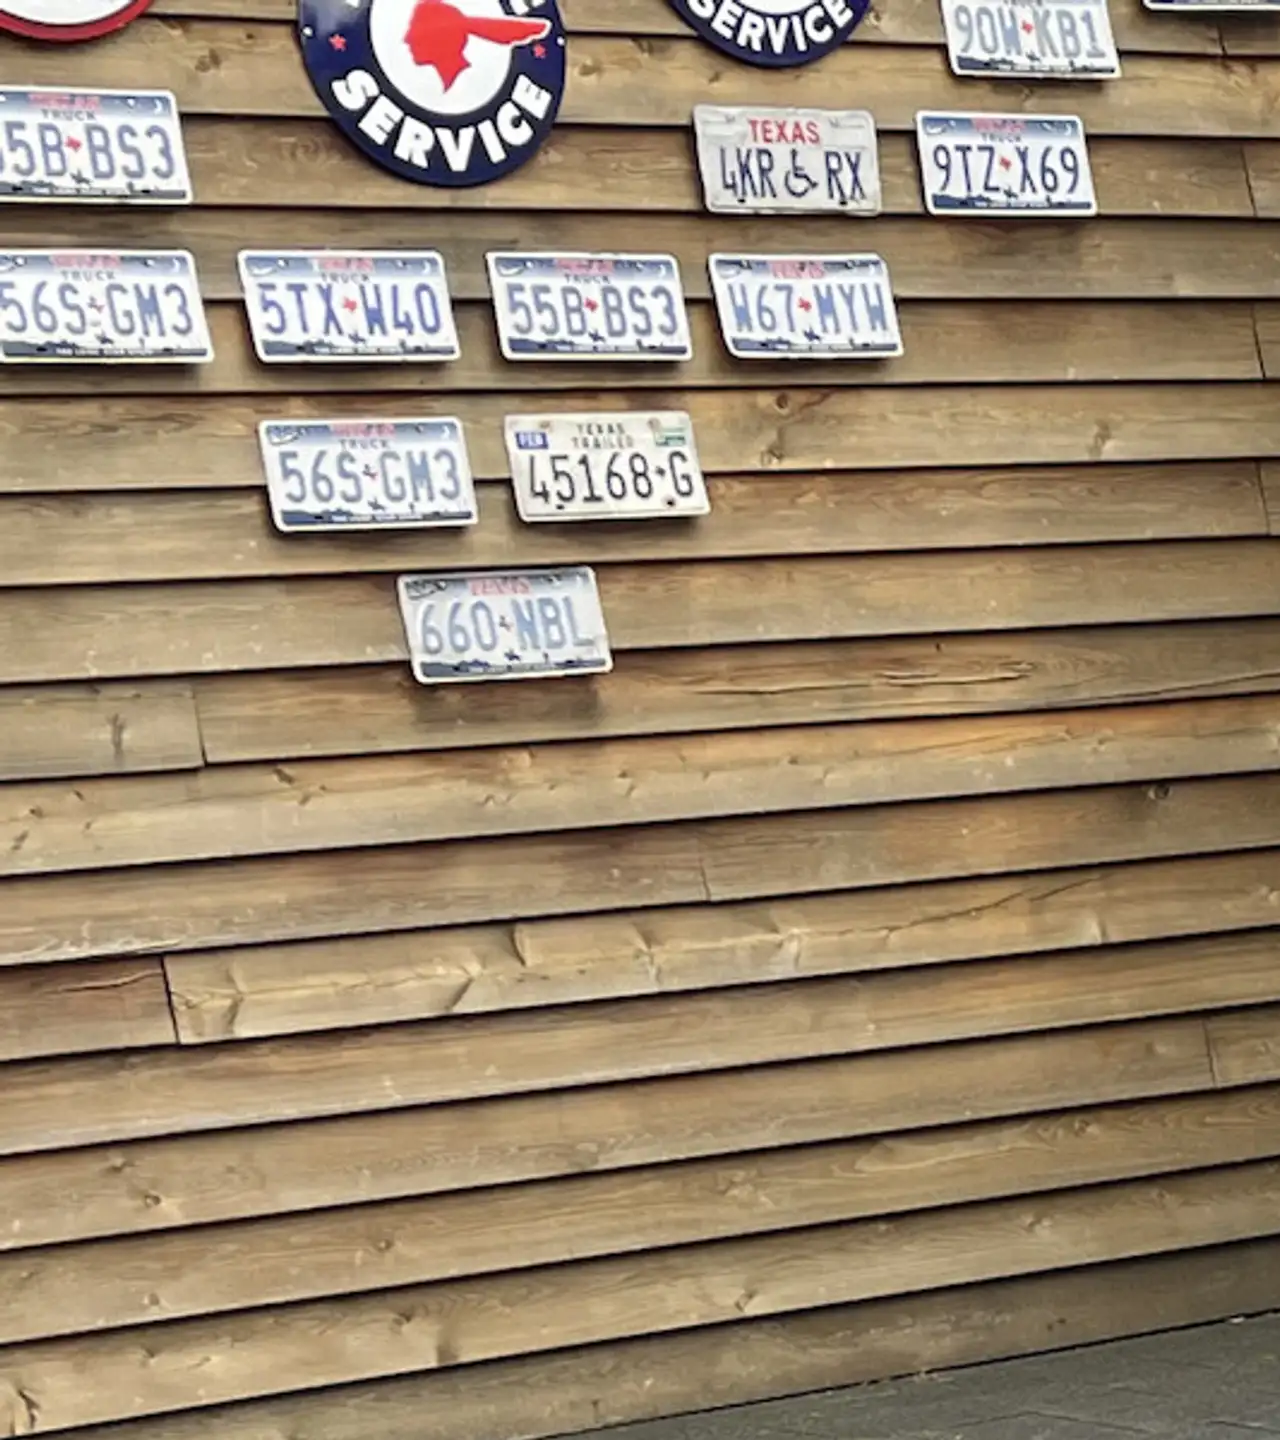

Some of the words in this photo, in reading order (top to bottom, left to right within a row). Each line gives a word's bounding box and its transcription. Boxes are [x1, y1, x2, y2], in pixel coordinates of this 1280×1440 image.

[331, 69, 551, 172] SERVICE
[748, 119, 820, 144] TEXAS
[0, 121, 67, 177] 5B
[720, 146, 777, 199] 4KR
[825, 151, 867, 200] RX
[530, 452, 653, 503] 45168
[668, 451, 694, 498] G
